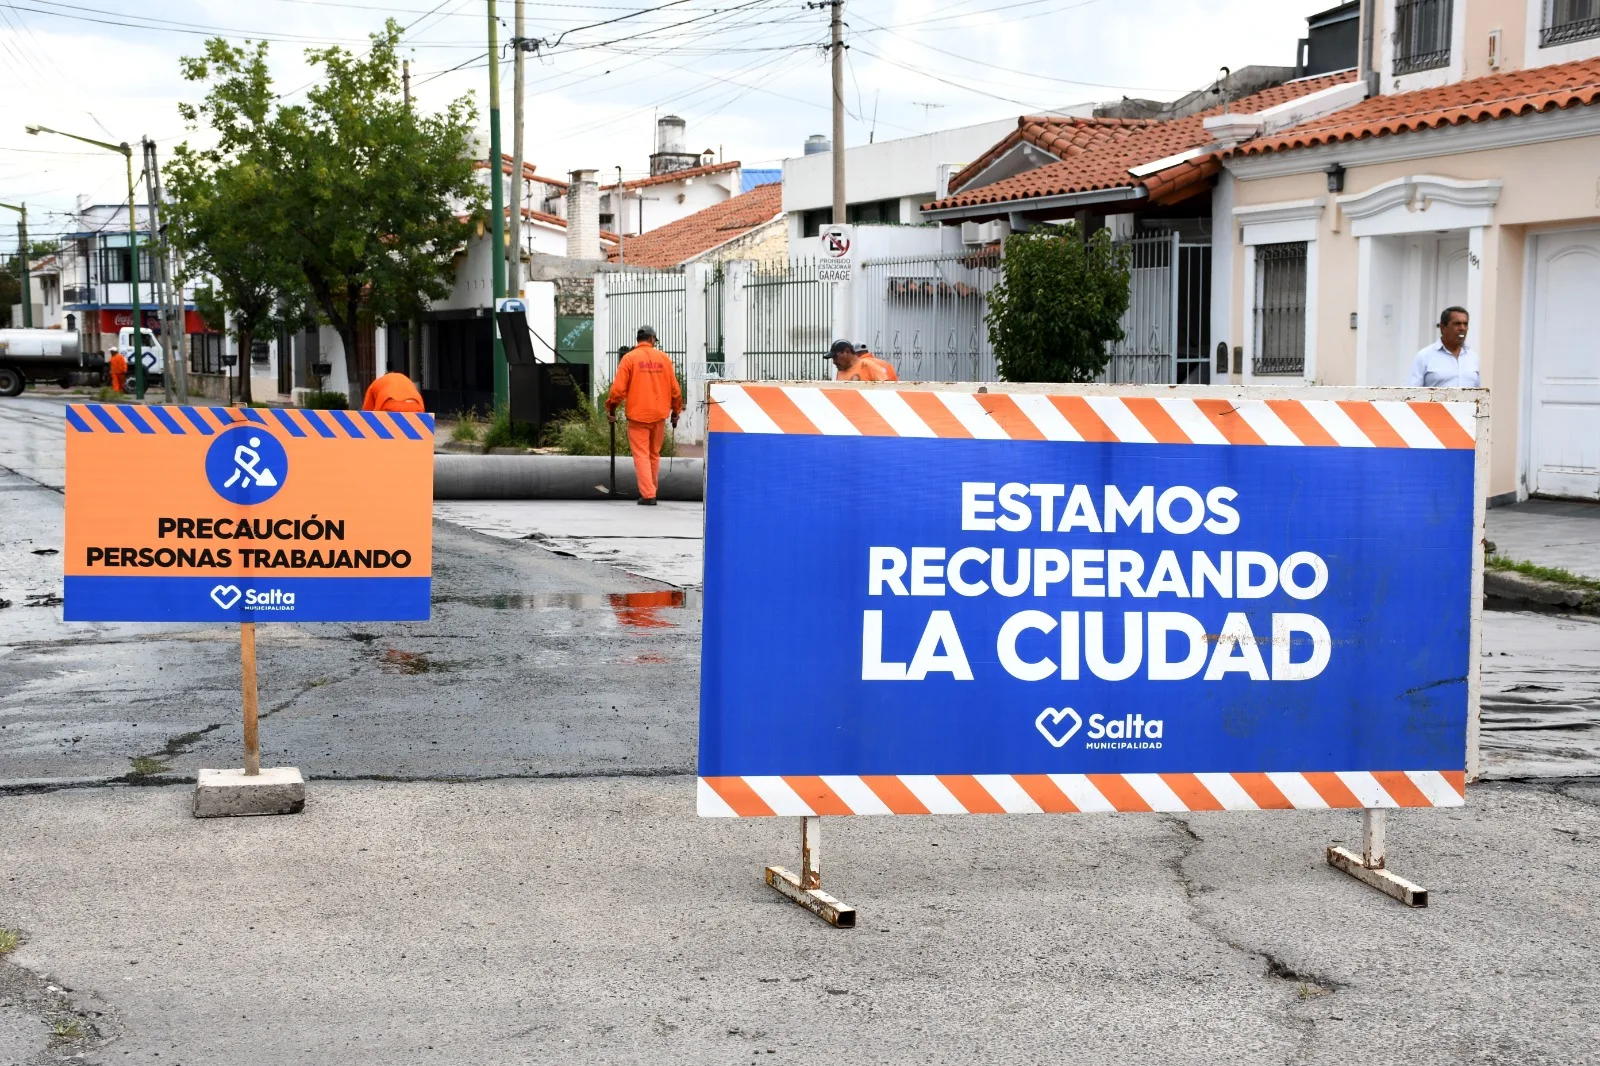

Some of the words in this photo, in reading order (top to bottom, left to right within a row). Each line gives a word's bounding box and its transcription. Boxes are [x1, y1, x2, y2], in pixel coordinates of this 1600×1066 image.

[819, 270, 851, 281] GARAGE
[961, 481, 1241, 535] ESTAMOS
[158, 514, 345, 541] PRECAUCIÓN
[86, 546, 232, 568] PERSONAS
[238, 548, 412, 569] TRABAJANDO
[868, 546, 1329, 600] RECUPERANDO
[245, 588, 296, 605] Salta
[861, 609, 975, 681] LA
[996, 609, 1332, 682] CIUDAD
[1087, 713, 1164, 739] Salta
[1086, 742, 1163, 750] MUNICIPALIDAD
